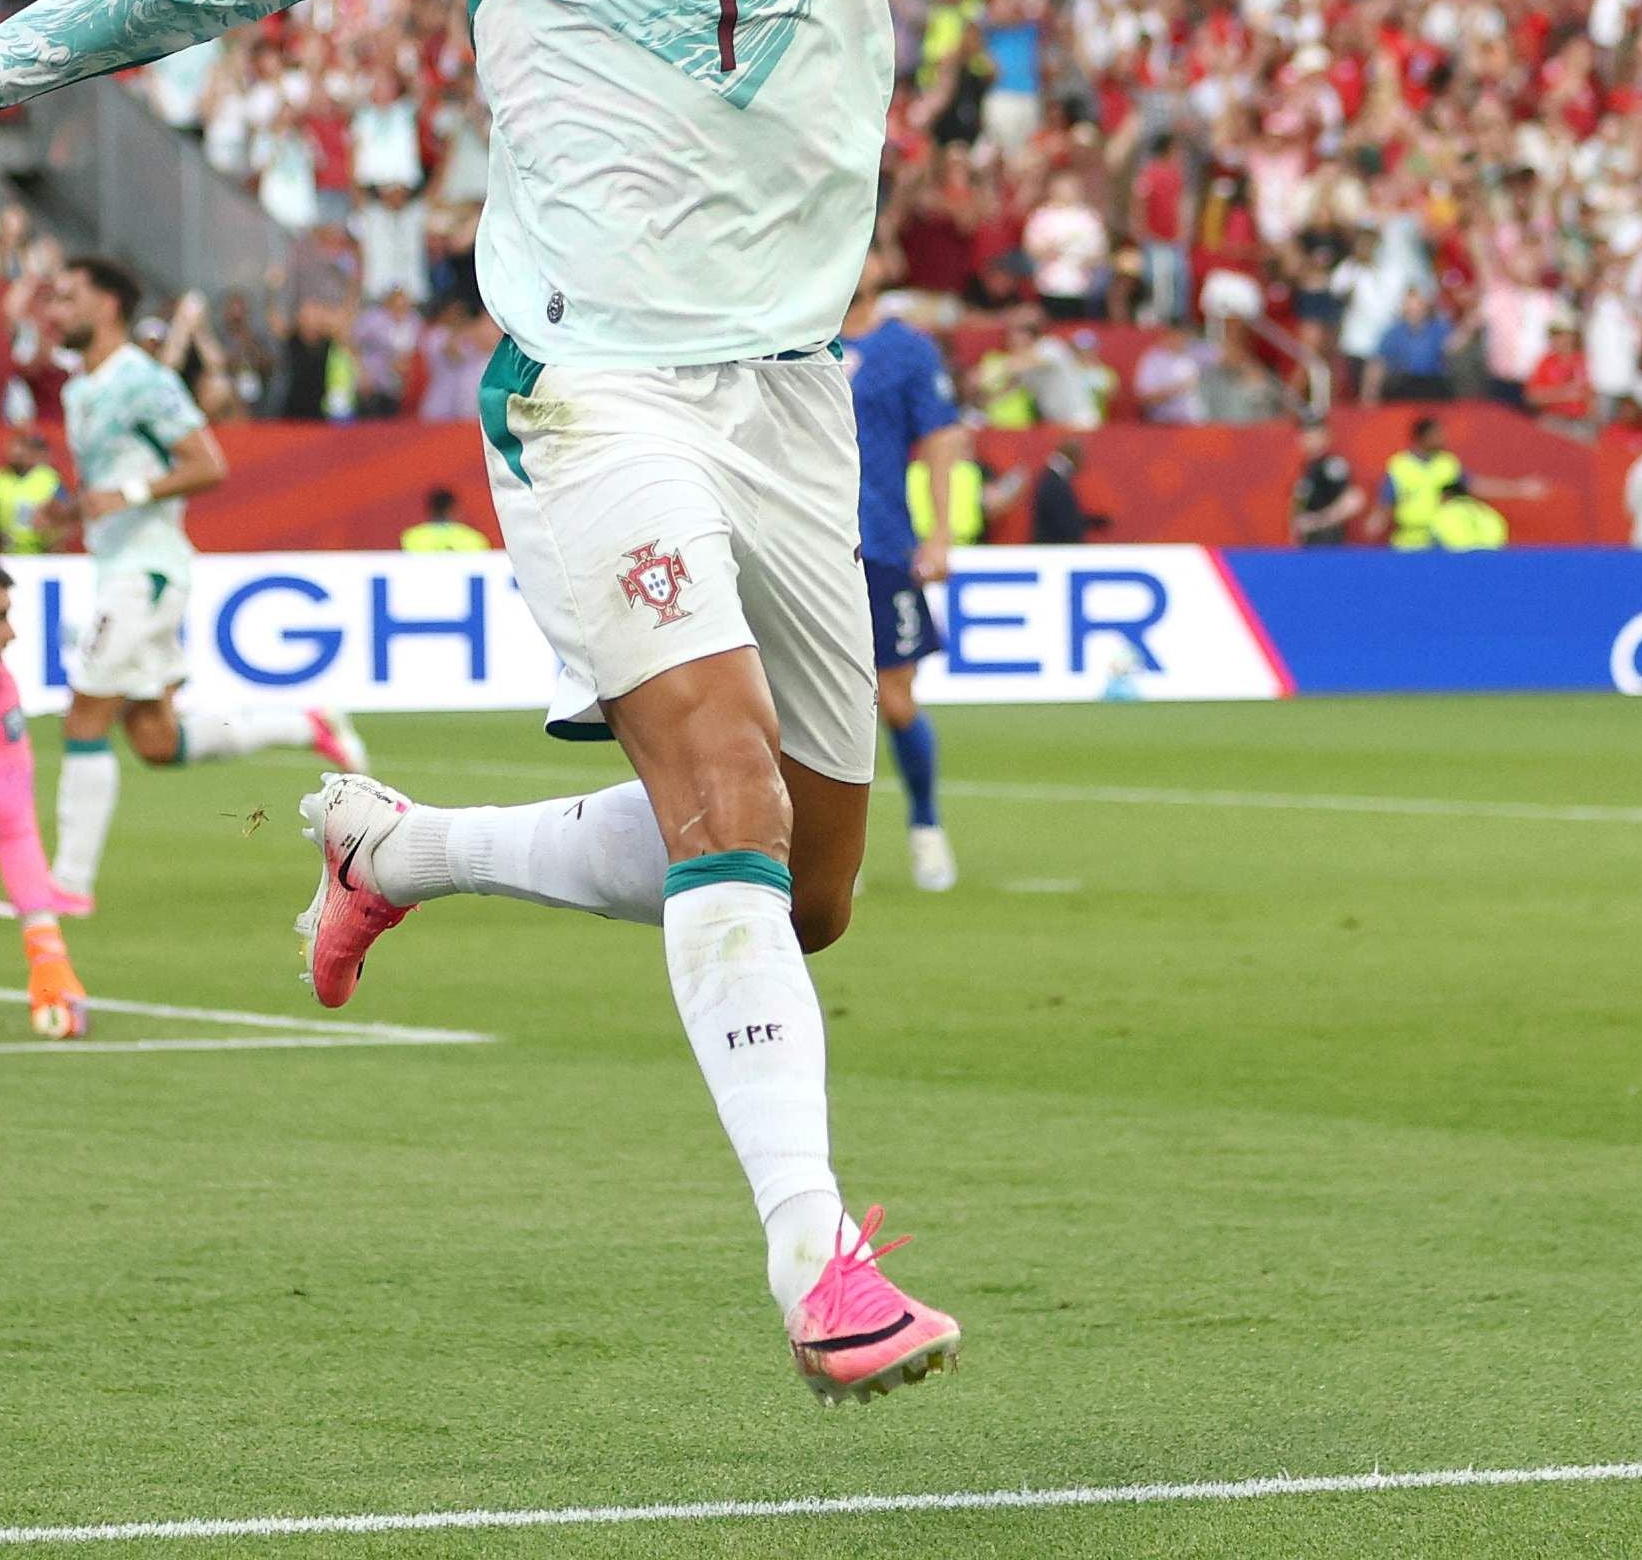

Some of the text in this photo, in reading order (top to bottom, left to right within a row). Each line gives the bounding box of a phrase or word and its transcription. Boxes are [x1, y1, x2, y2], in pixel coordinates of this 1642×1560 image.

[44, 575, 519, 686] LGH
[947, 570, 1167, 674] ER
[726, 1024, 783, 1050] F.P.F.
